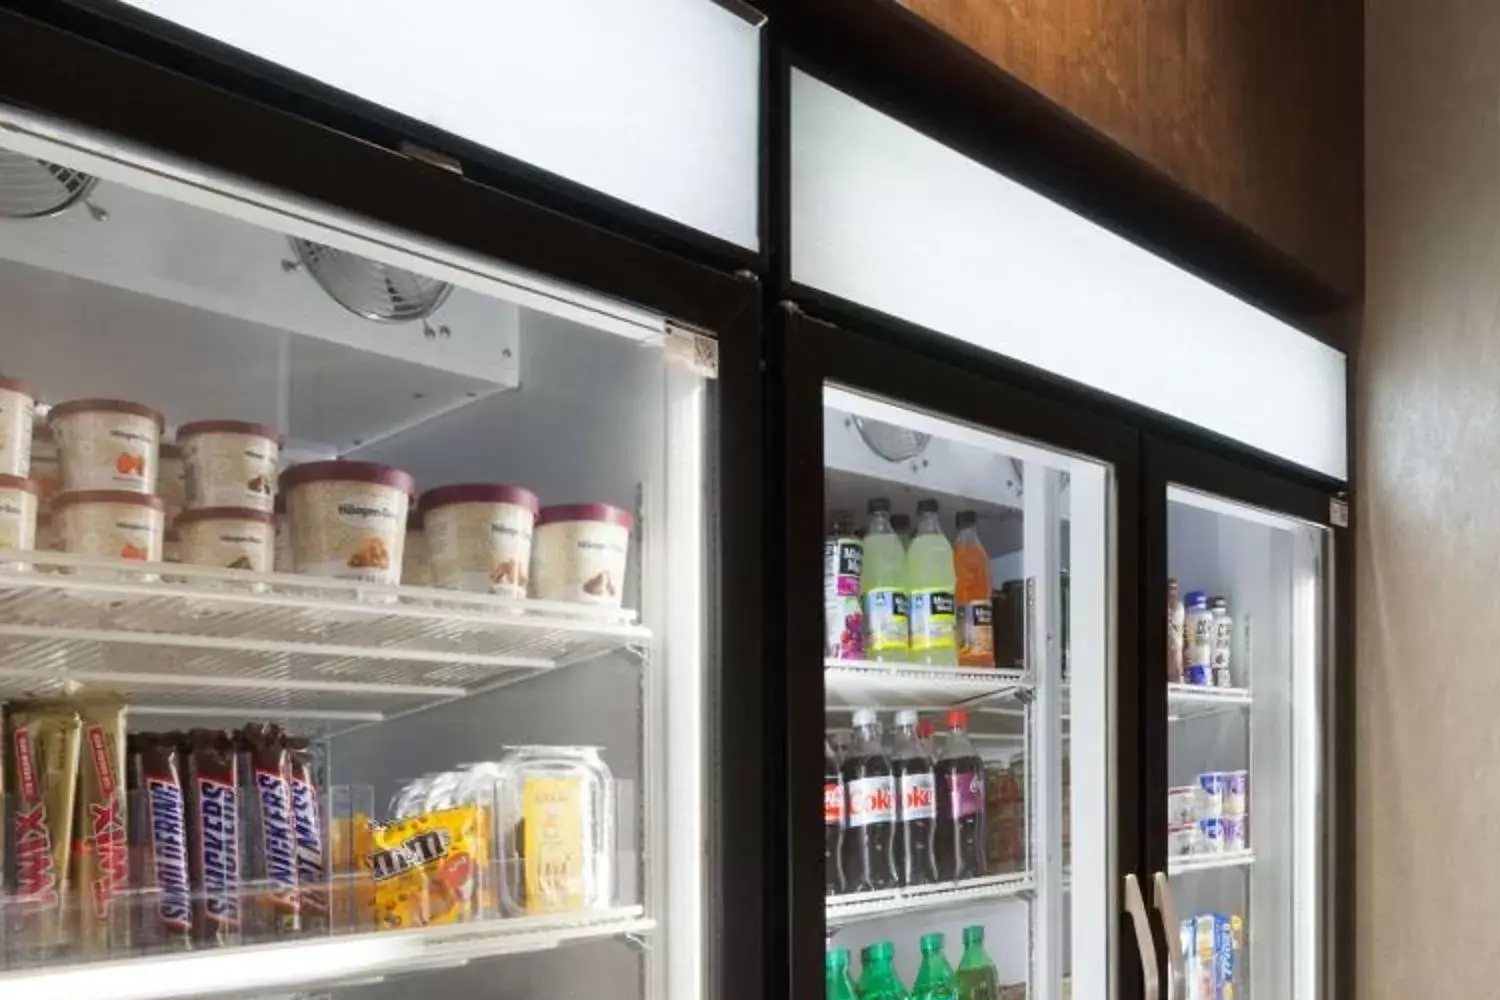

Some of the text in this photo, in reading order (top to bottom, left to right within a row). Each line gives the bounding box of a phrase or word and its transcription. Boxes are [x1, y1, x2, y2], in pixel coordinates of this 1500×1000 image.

[90, 800, 130, 917] TWIX
[200, 781, 238, 919] SNICKERS
[257, 773, 297, 890] NICKERS
